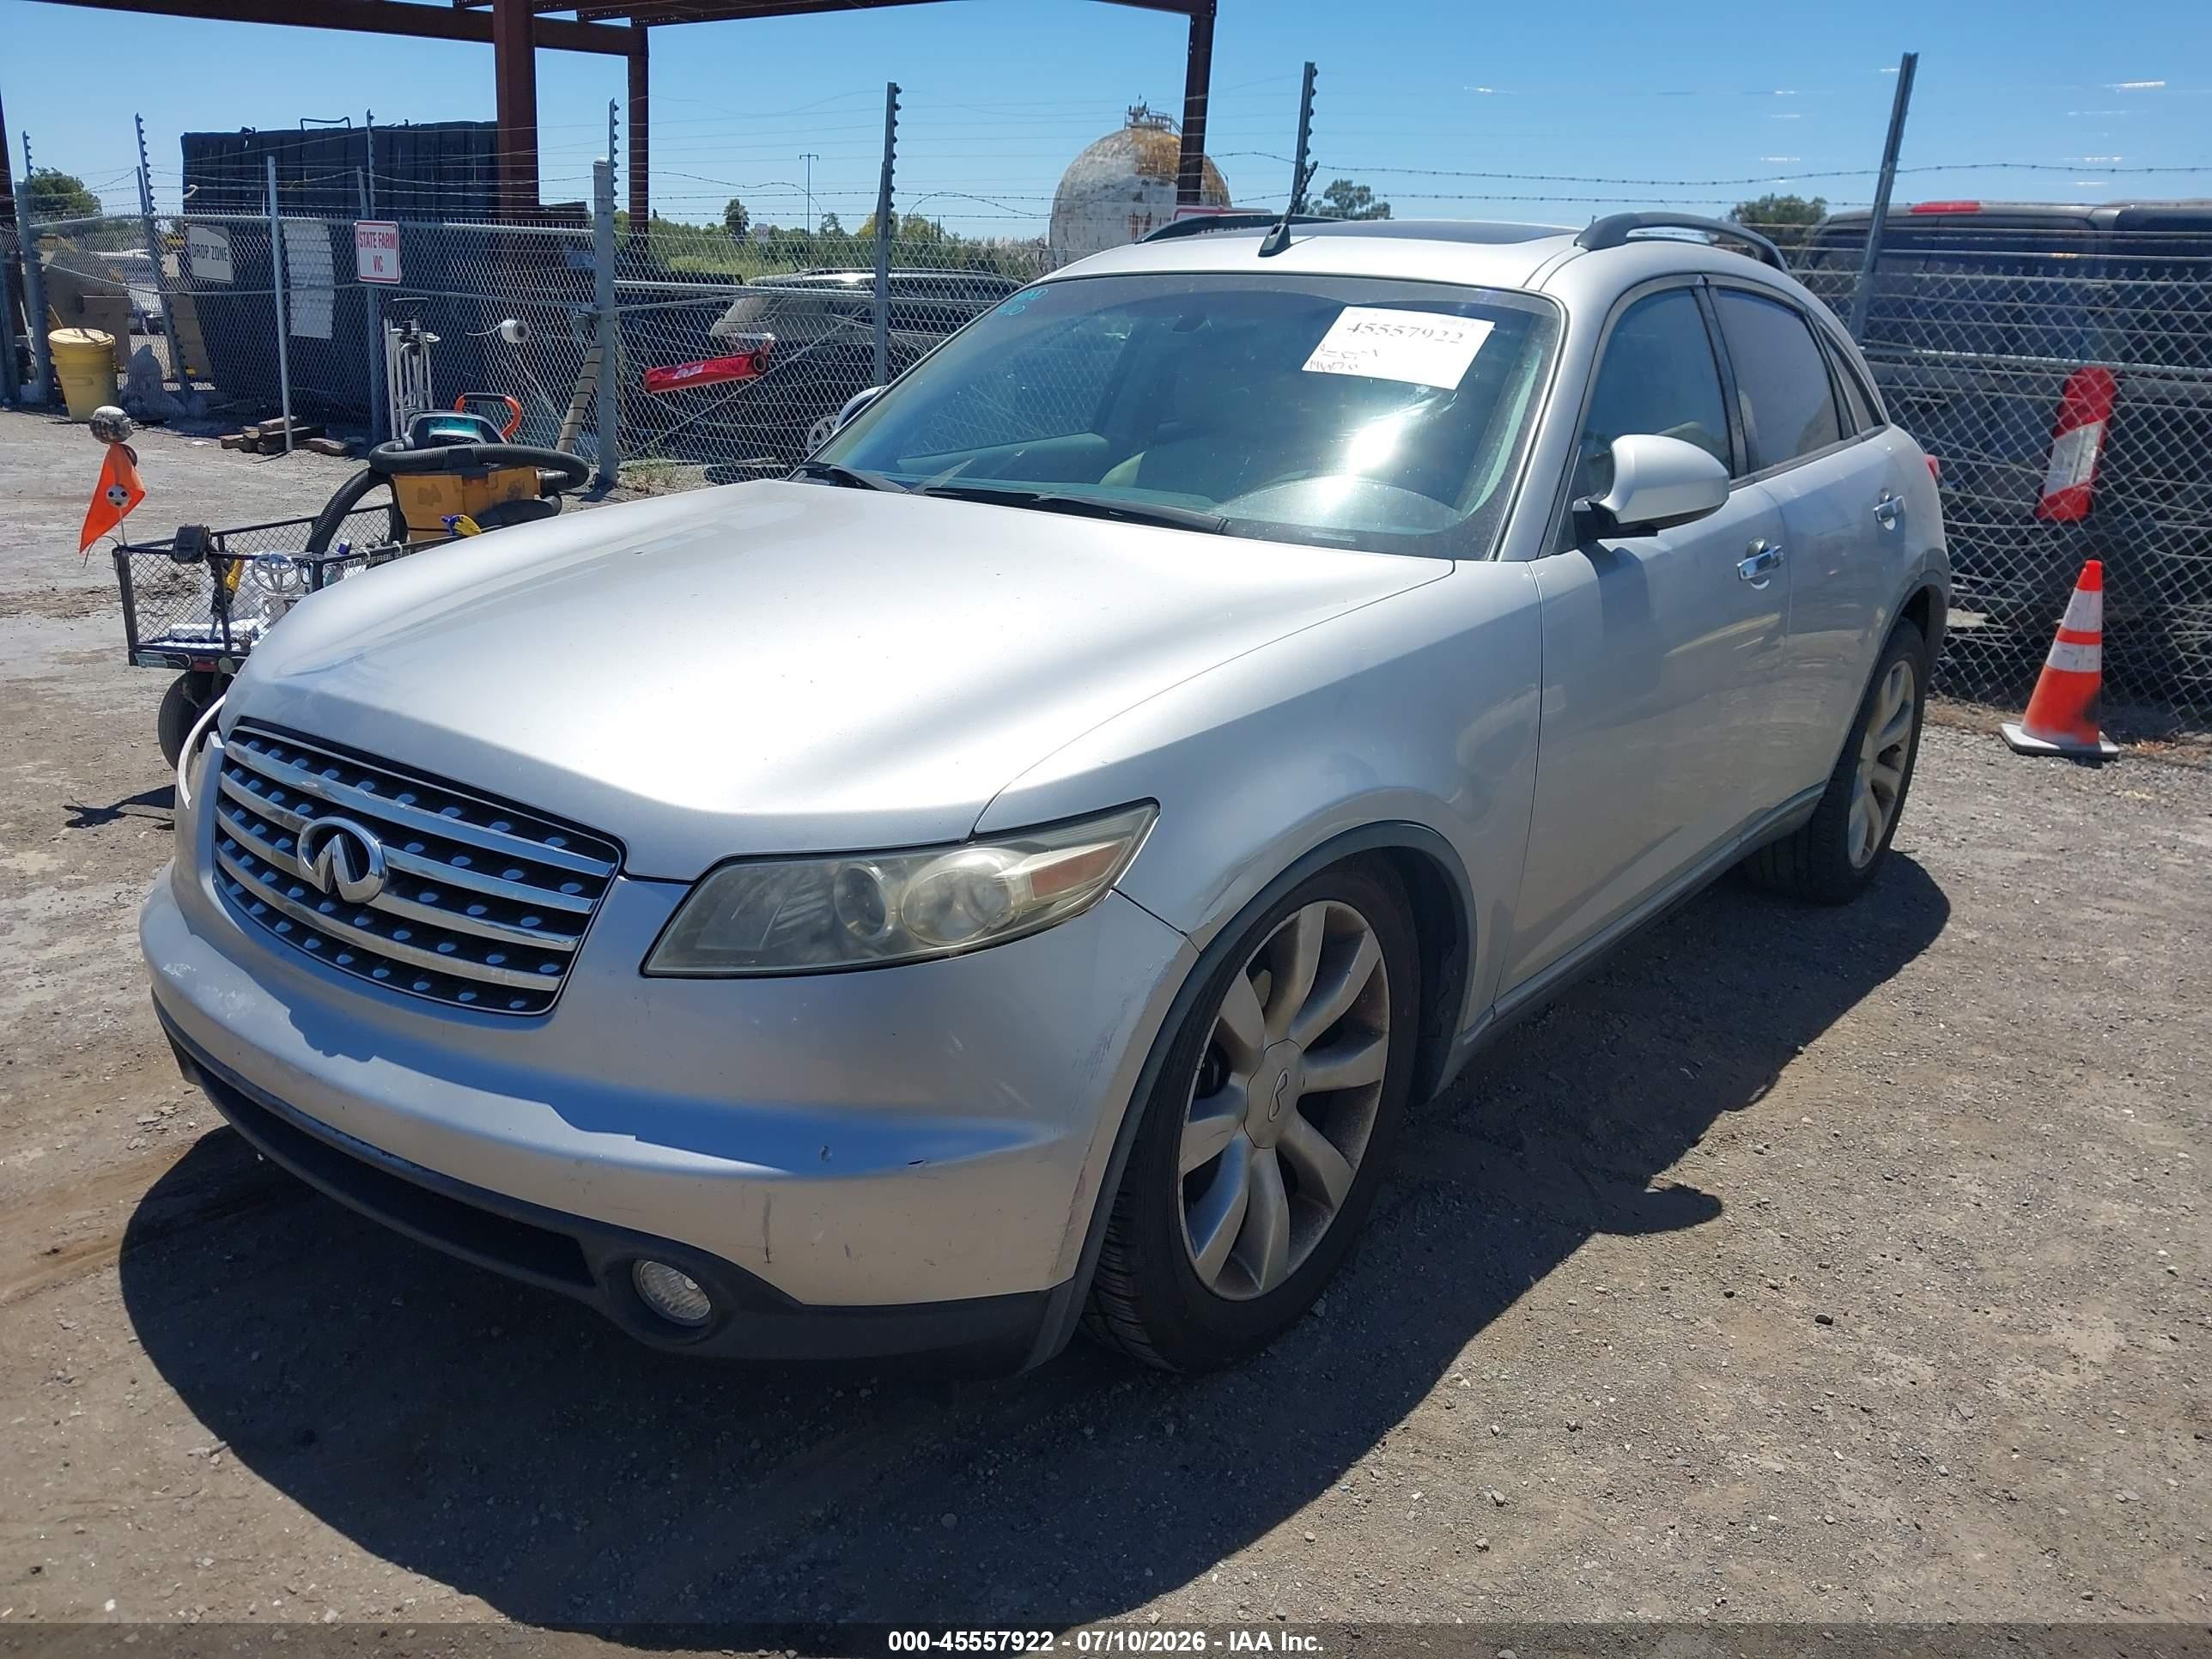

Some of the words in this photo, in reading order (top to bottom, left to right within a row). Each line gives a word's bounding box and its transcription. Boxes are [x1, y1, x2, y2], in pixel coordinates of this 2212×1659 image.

[359, 231, 377, 249] STATE
[378, 232, 396, 250] FARM
[191, 243, 210, 259] DROP
[210, 246, 228, 262] ZONE
[373, 254, 384, 273] VIC
